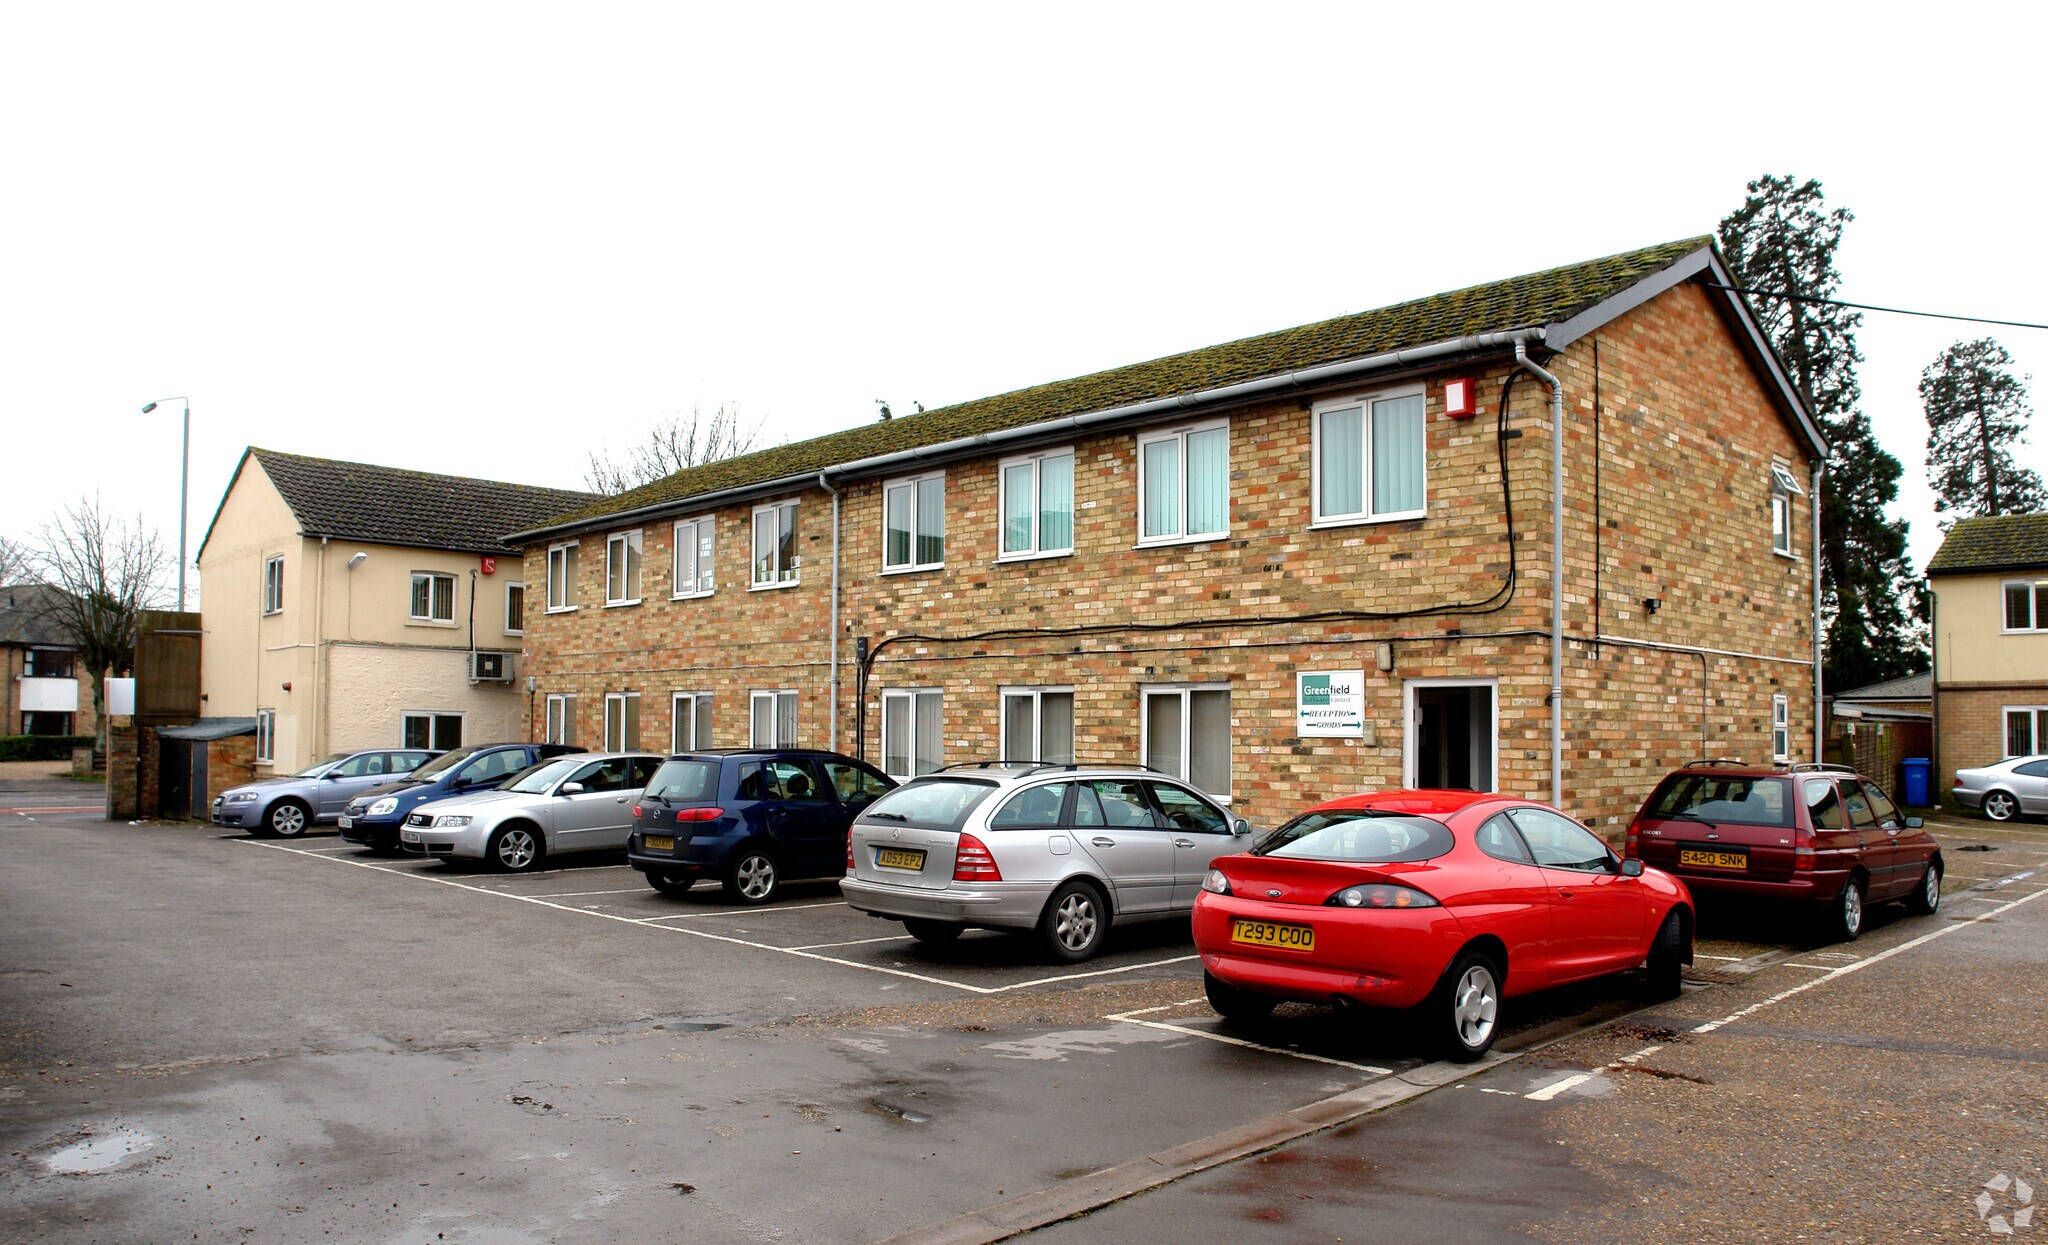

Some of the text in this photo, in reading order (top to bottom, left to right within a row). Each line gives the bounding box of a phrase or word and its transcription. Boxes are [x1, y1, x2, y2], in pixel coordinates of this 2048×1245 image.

[1303, 684, 1350, 695] Greenfield
[1308, 710, 1351, 718] RECEPTION
[1316, 721, 1342, 729] GOODS
[881, 851, 923, 867] AD53 EPZ
[1682, 851, 1745, 867] S420 SNK
[1236, 921, 1313, 946] T293 COO
